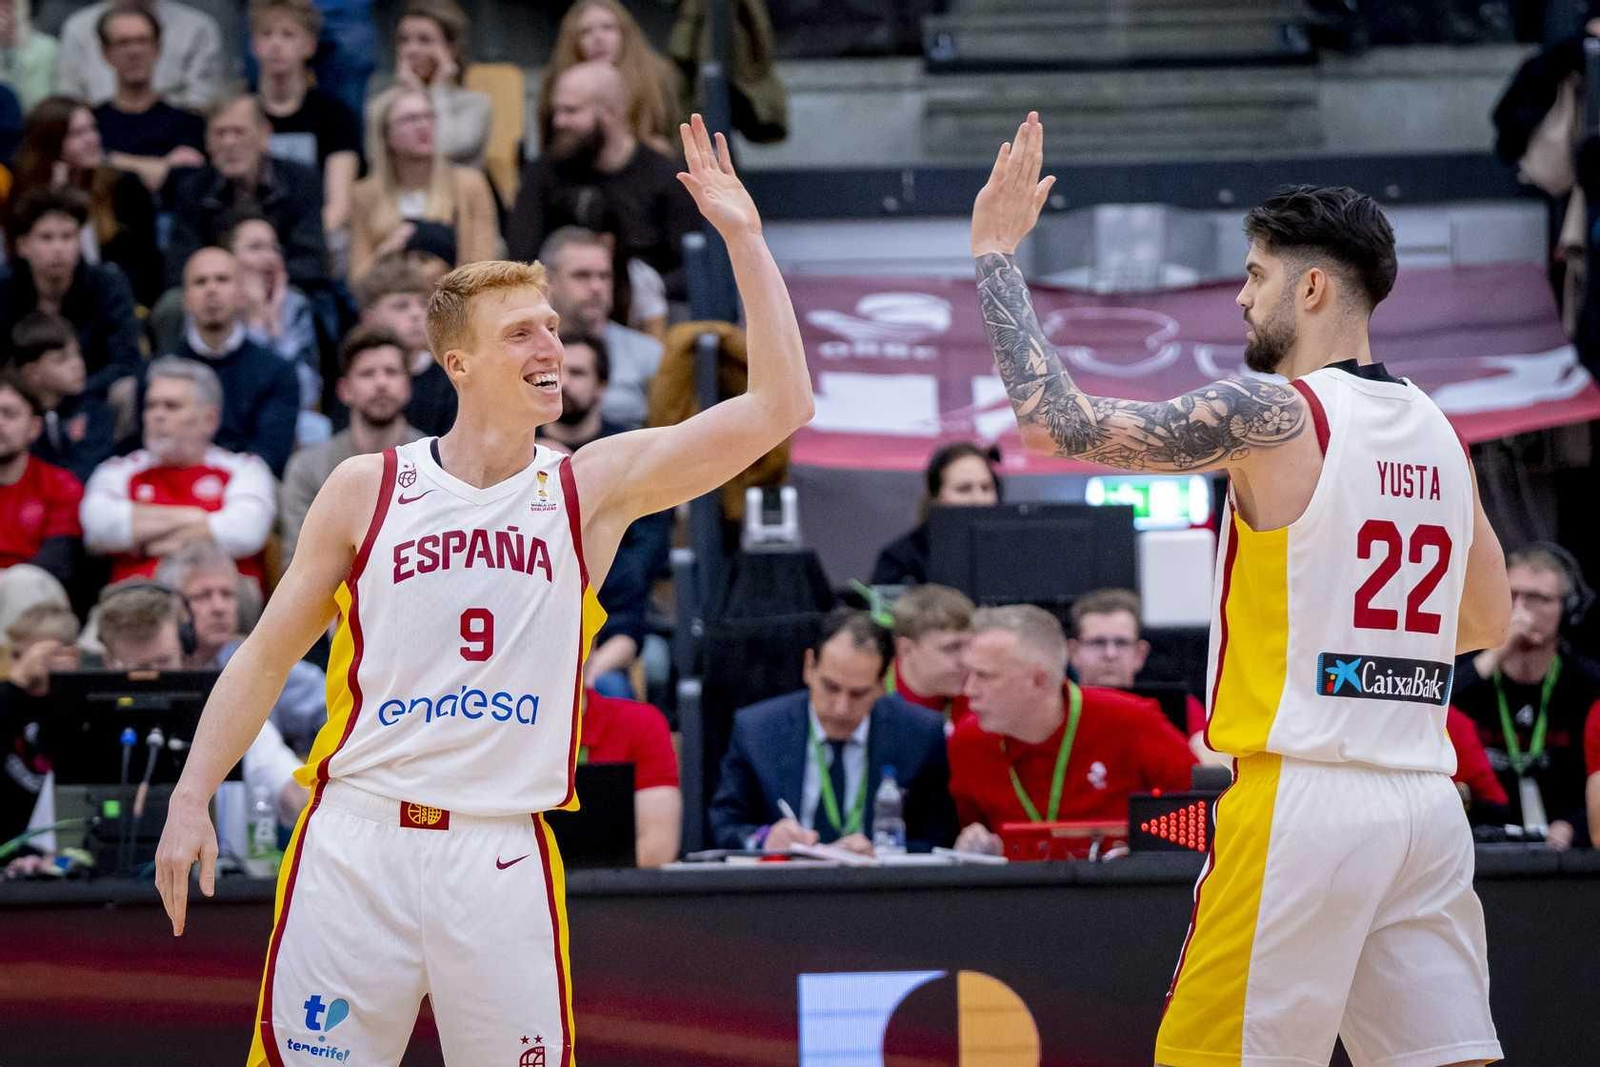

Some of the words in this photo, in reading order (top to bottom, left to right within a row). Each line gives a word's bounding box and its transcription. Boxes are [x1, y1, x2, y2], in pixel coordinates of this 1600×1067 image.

[1377, 461, 1441, 500] YUSTA
[393, 525, 553, 584] ESPAÑA
[1354, 519, 1453, 634] 22
[460, 608, 494, 661] 9
[1362, 661, 1444, 700] CaixaBank
[378, 685, 539, 726] endesa
